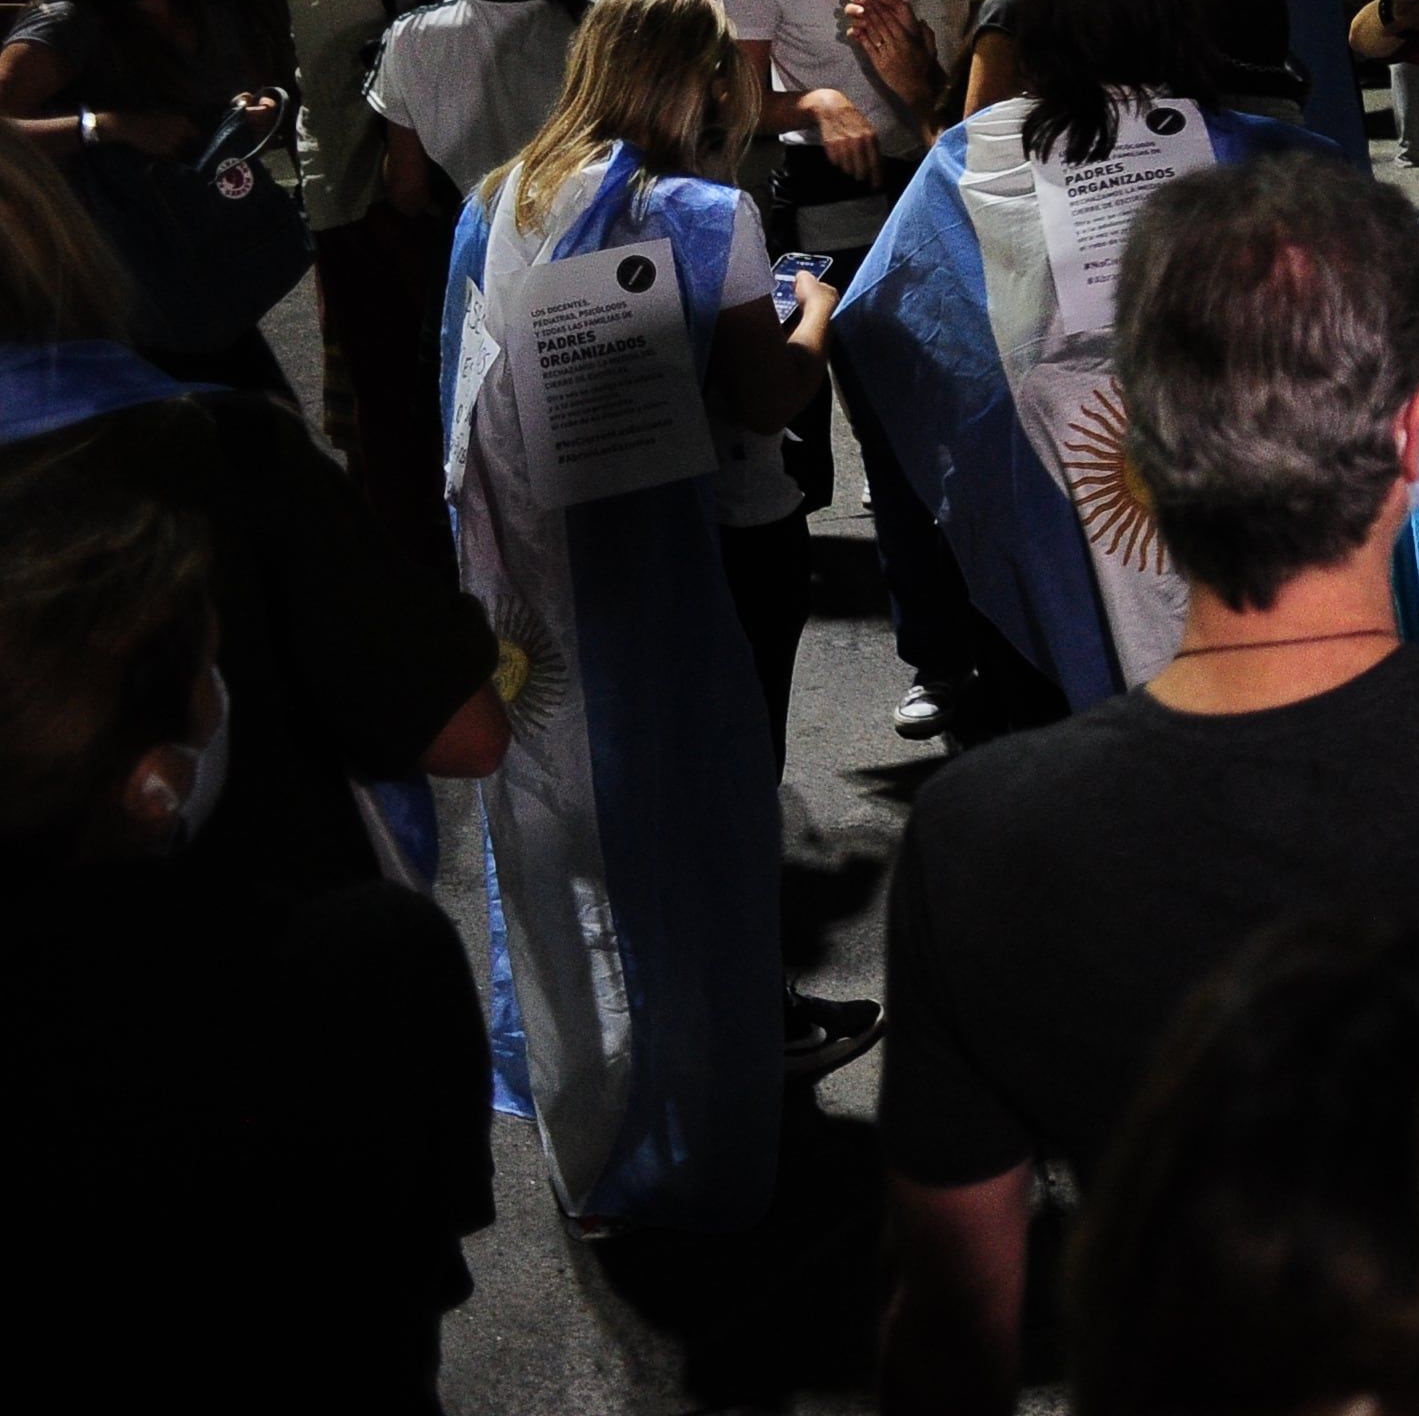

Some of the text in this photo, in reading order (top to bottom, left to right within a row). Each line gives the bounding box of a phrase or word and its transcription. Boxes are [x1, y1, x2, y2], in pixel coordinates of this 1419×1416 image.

[1065, 162, 1124, 185] PADRES
[1067, 167, 1175, 198] ORGANIZADOS
[537, 330, 596, 353] PADRES
[540, 335, 646, 368] ORGANIZADOS
